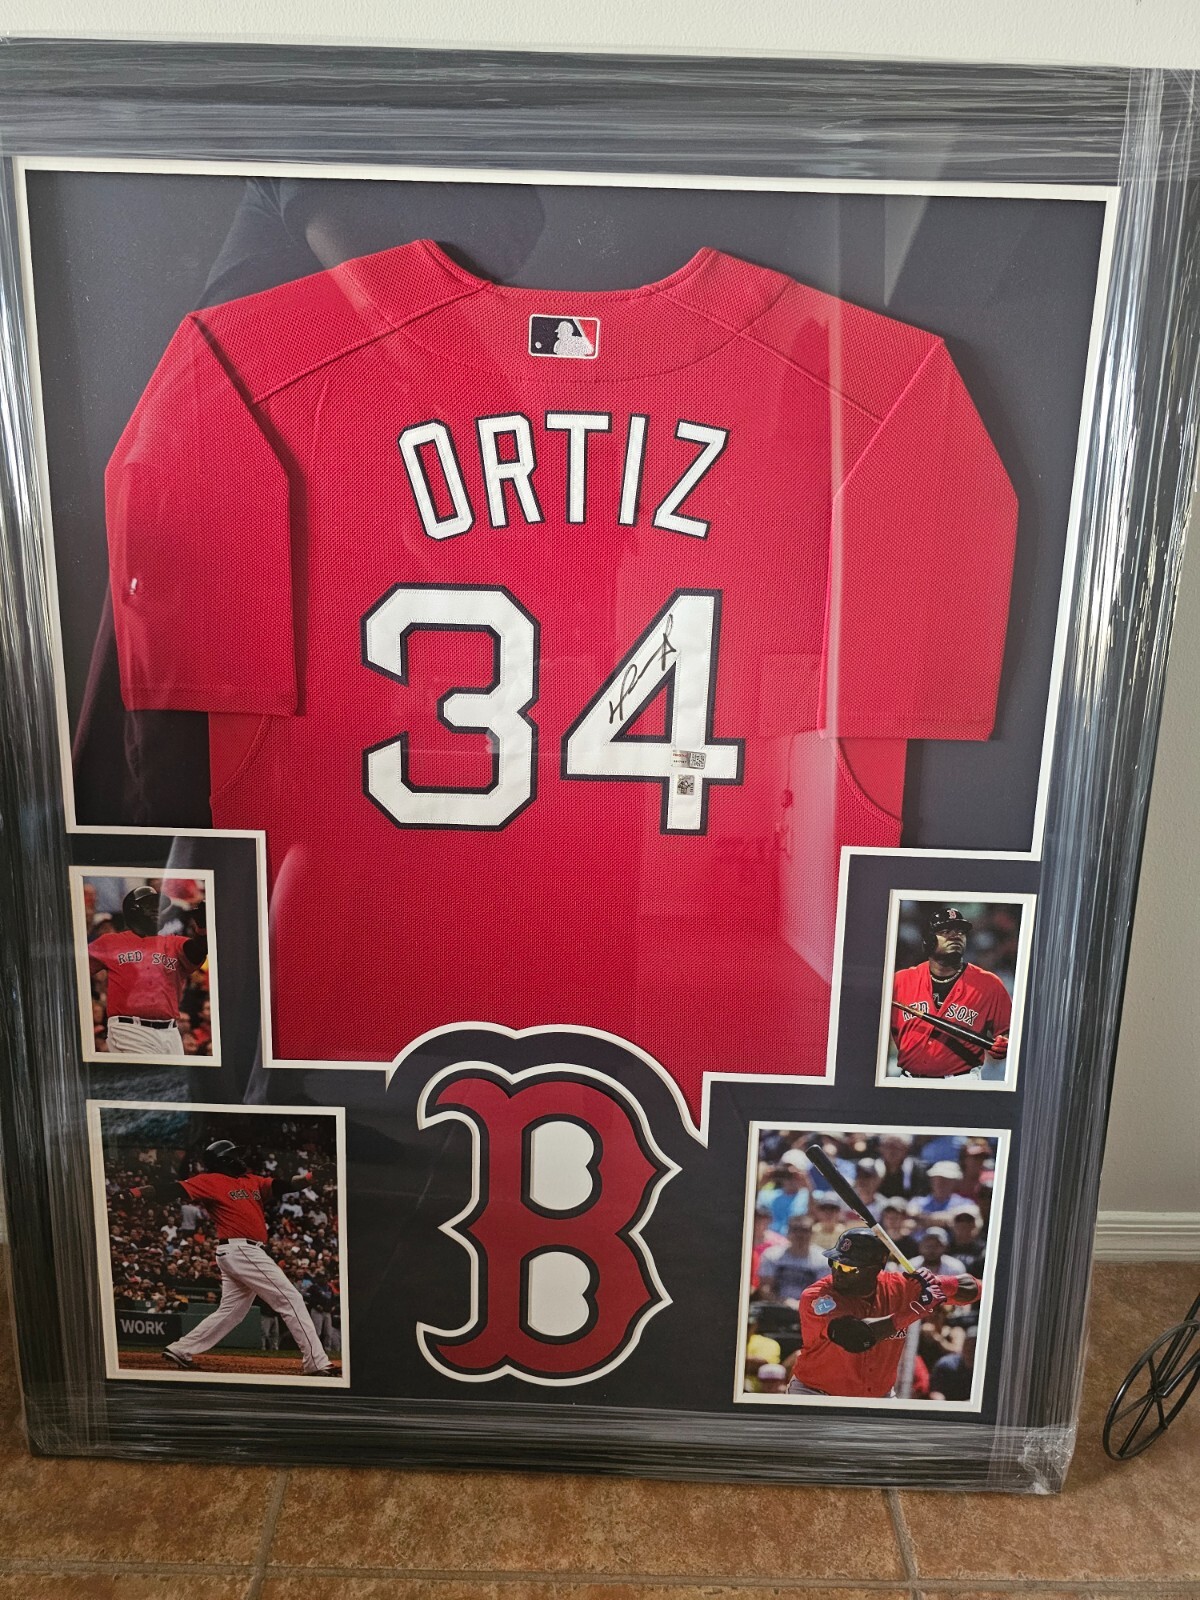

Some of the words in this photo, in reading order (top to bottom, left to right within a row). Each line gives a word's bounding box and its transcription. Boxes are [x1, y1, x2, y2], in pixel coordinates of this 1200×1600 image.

[399, 412, 730, 541] ORTIZ
[362, 585, 745, 834] 34
[118, 950, 143, 965] RED
[945, 1003, 978, 1026] SOX
[228, 1190, 249, 1200] RED
[416, 1060, 683, 1387] B
[120, 1319, 165, 1335] WORK
